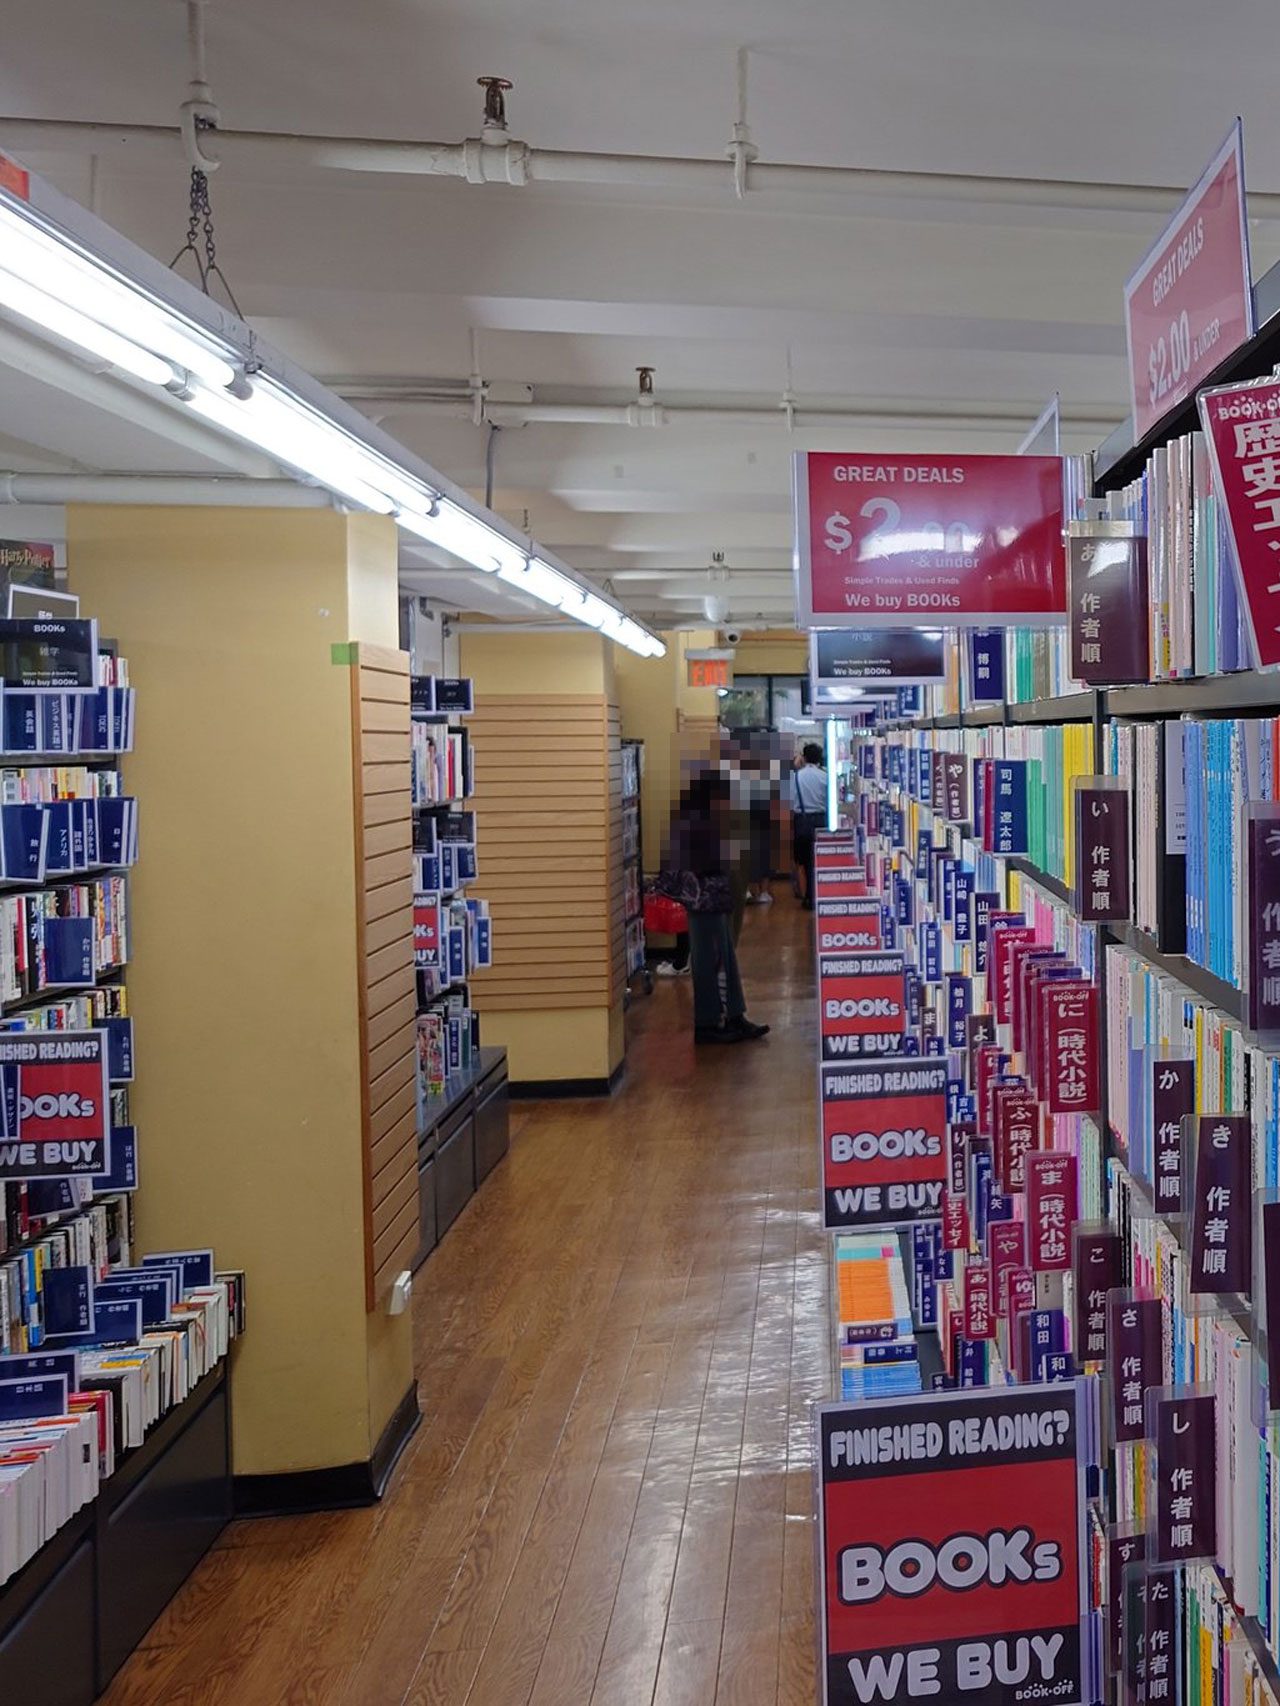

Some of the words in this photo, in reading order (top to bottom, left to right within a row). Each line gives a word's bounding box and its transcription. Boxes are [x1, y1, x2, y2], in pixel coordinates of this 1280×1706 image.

[1153, 274, 1177, 307] GREAT
[1177, 217, 1204, 274] DEALS
[833, 466, 898, 483] GREAT
[903, 467, 965, 484] DEALS
[936, 554, 979, 569] under
[845, 593, 871, 606] We
[875, 593, 903, 610] buy
[1080, 593, 1101, 663] 作者順
[1090, 846, 1111, 911] 作者順
[822, 959, 861, 975] FINISHED
[862, 956, 902, 972] READING?
[826, 998, 899, 1018] BOOKs
[39, 1041, 99, 1059] READING?
[828, 1036, 862, 1053] WE
[864, 1033, 900, 1051] BUY
[20, 1093, 94, 1118] OOKs
[825, 1075, 882, 1095] FINISHED
[883, 1070, 945, 1092] READING?
[43, 1140, 96, 1165] BUY
[830, 1128, 942, 1163] BOOKs
[1158, 1123, 1181, 1208] 作者順
[834, 1186, 882, 1214] WE
[888, 1182, 943, 1209] BUY
[1203, 1186, 1232, 1274] 作者順
[1087, 1290, 1106, 1352] 作者順
[1121, 1356, 1143, 1427] 作者順
[830, 1422, 943, 1468] FINISHED
[949, 1411, 1070, 1455] READING?
[1170, 1468, 1193, 1548] 作者順
[841, 1529, 1061, 1602] BOOKs
[848, 1648, 941, 1704] WE
[957, 1633, 1065, 1690] BUY
[1150, 1630, 1170, 1699] 作者順
